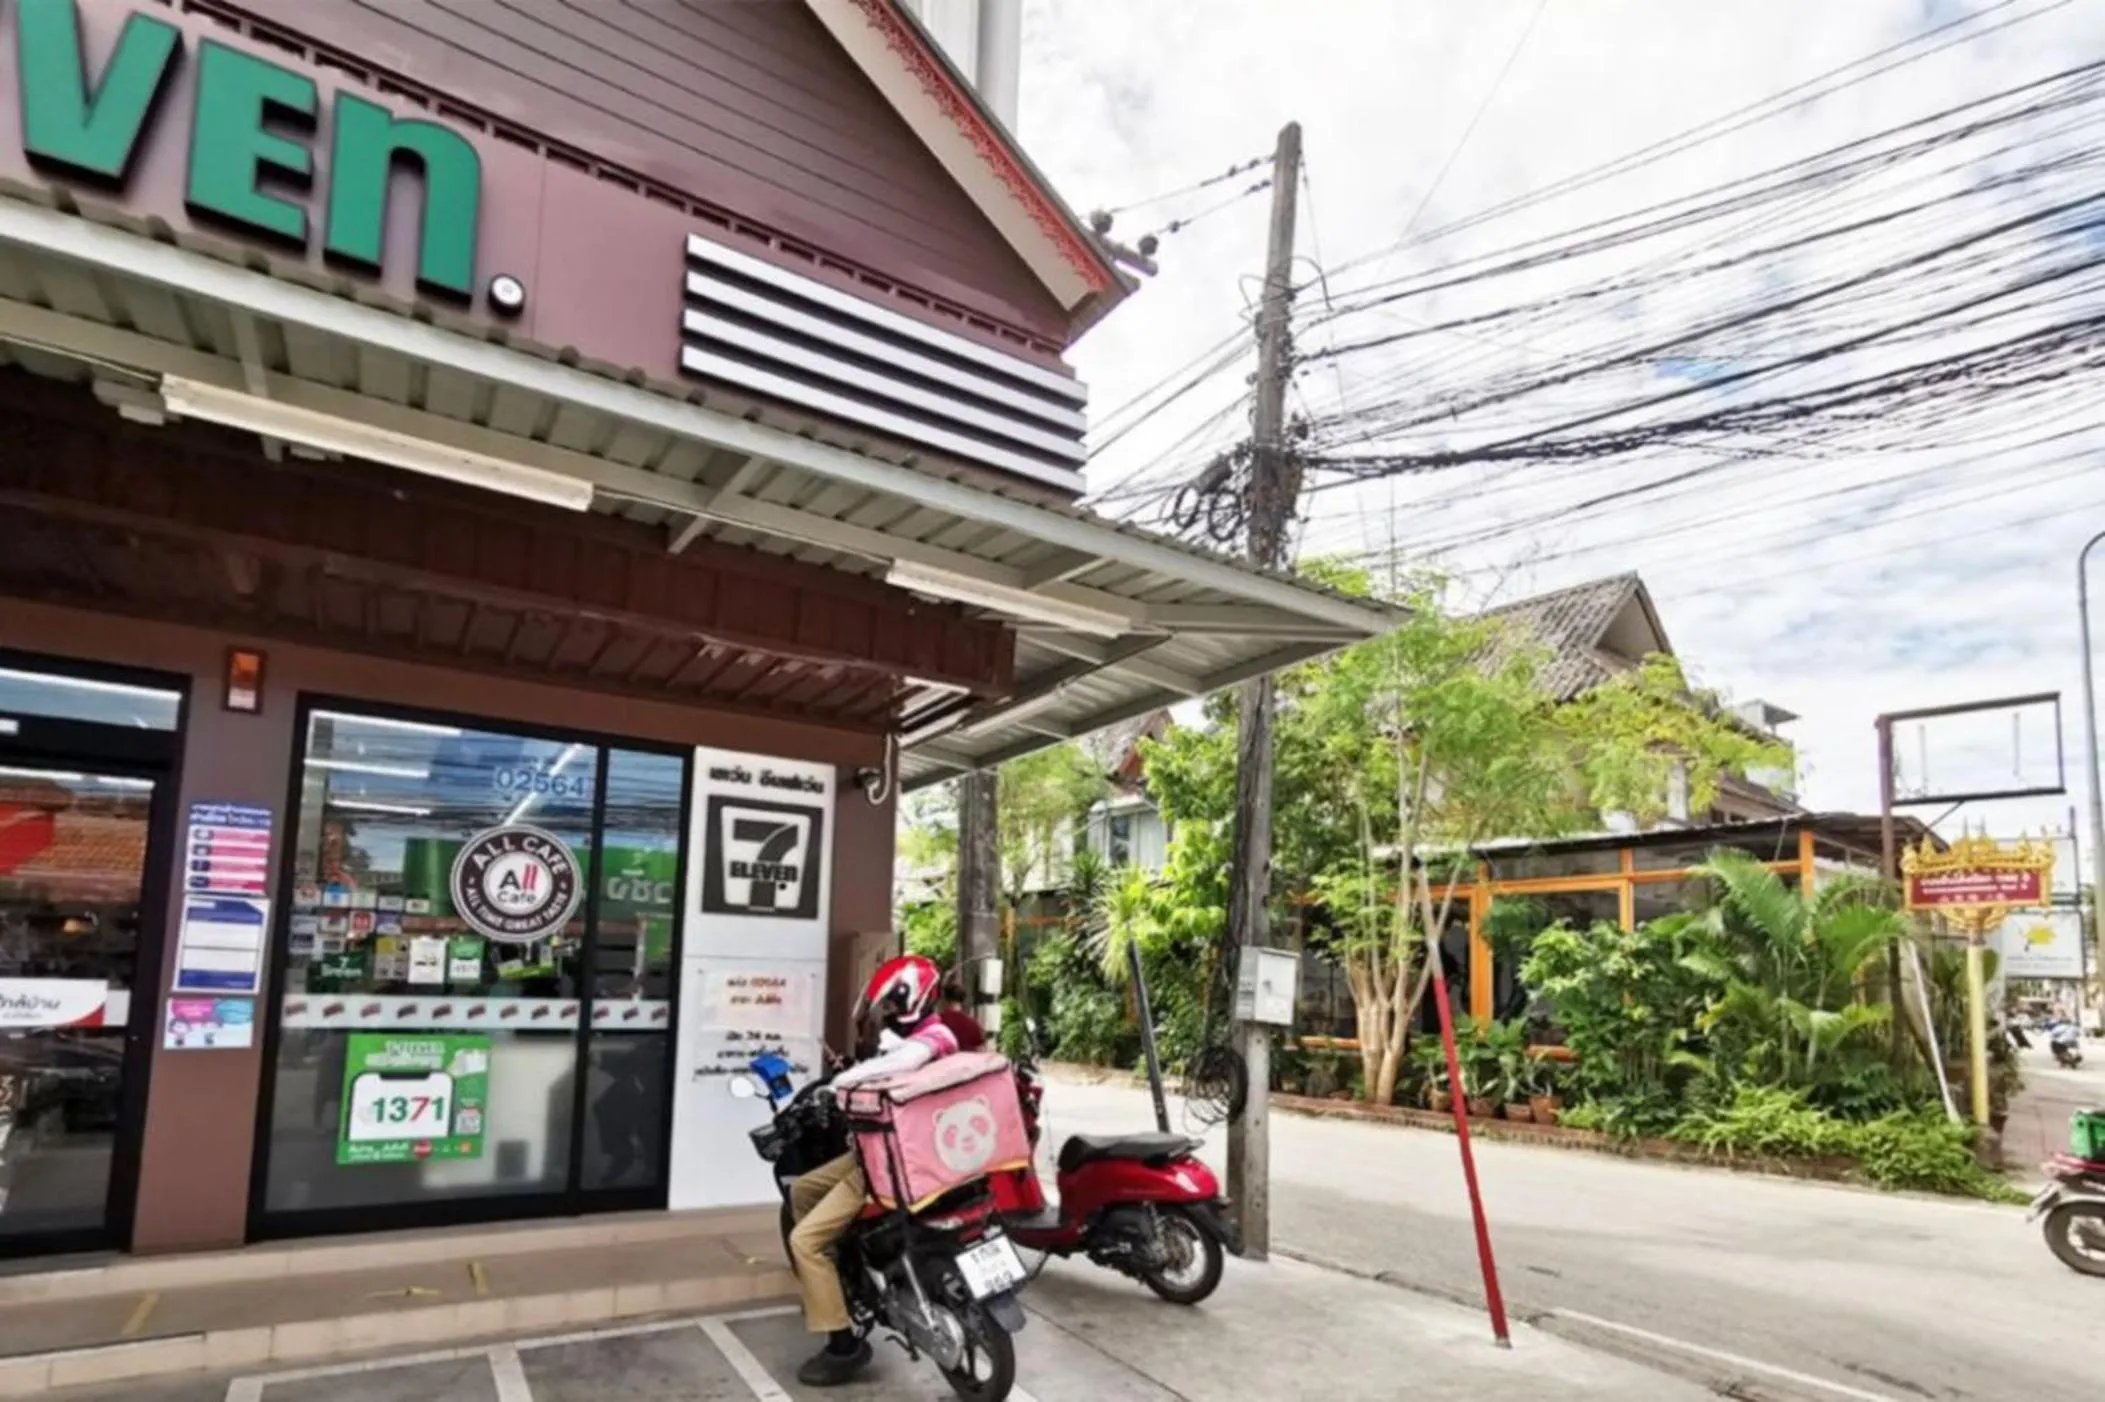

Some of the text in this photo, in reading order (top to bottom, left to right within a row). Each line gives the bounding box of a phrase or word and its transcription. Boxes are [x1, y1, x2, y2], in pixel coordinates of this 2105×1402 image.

[496, 766, 586, 797] 02564
[472, 835, 569, 875] ALL CAFE
[732, 818, 799, 922] 7
[371, 1095, 445, 1123] 1371
